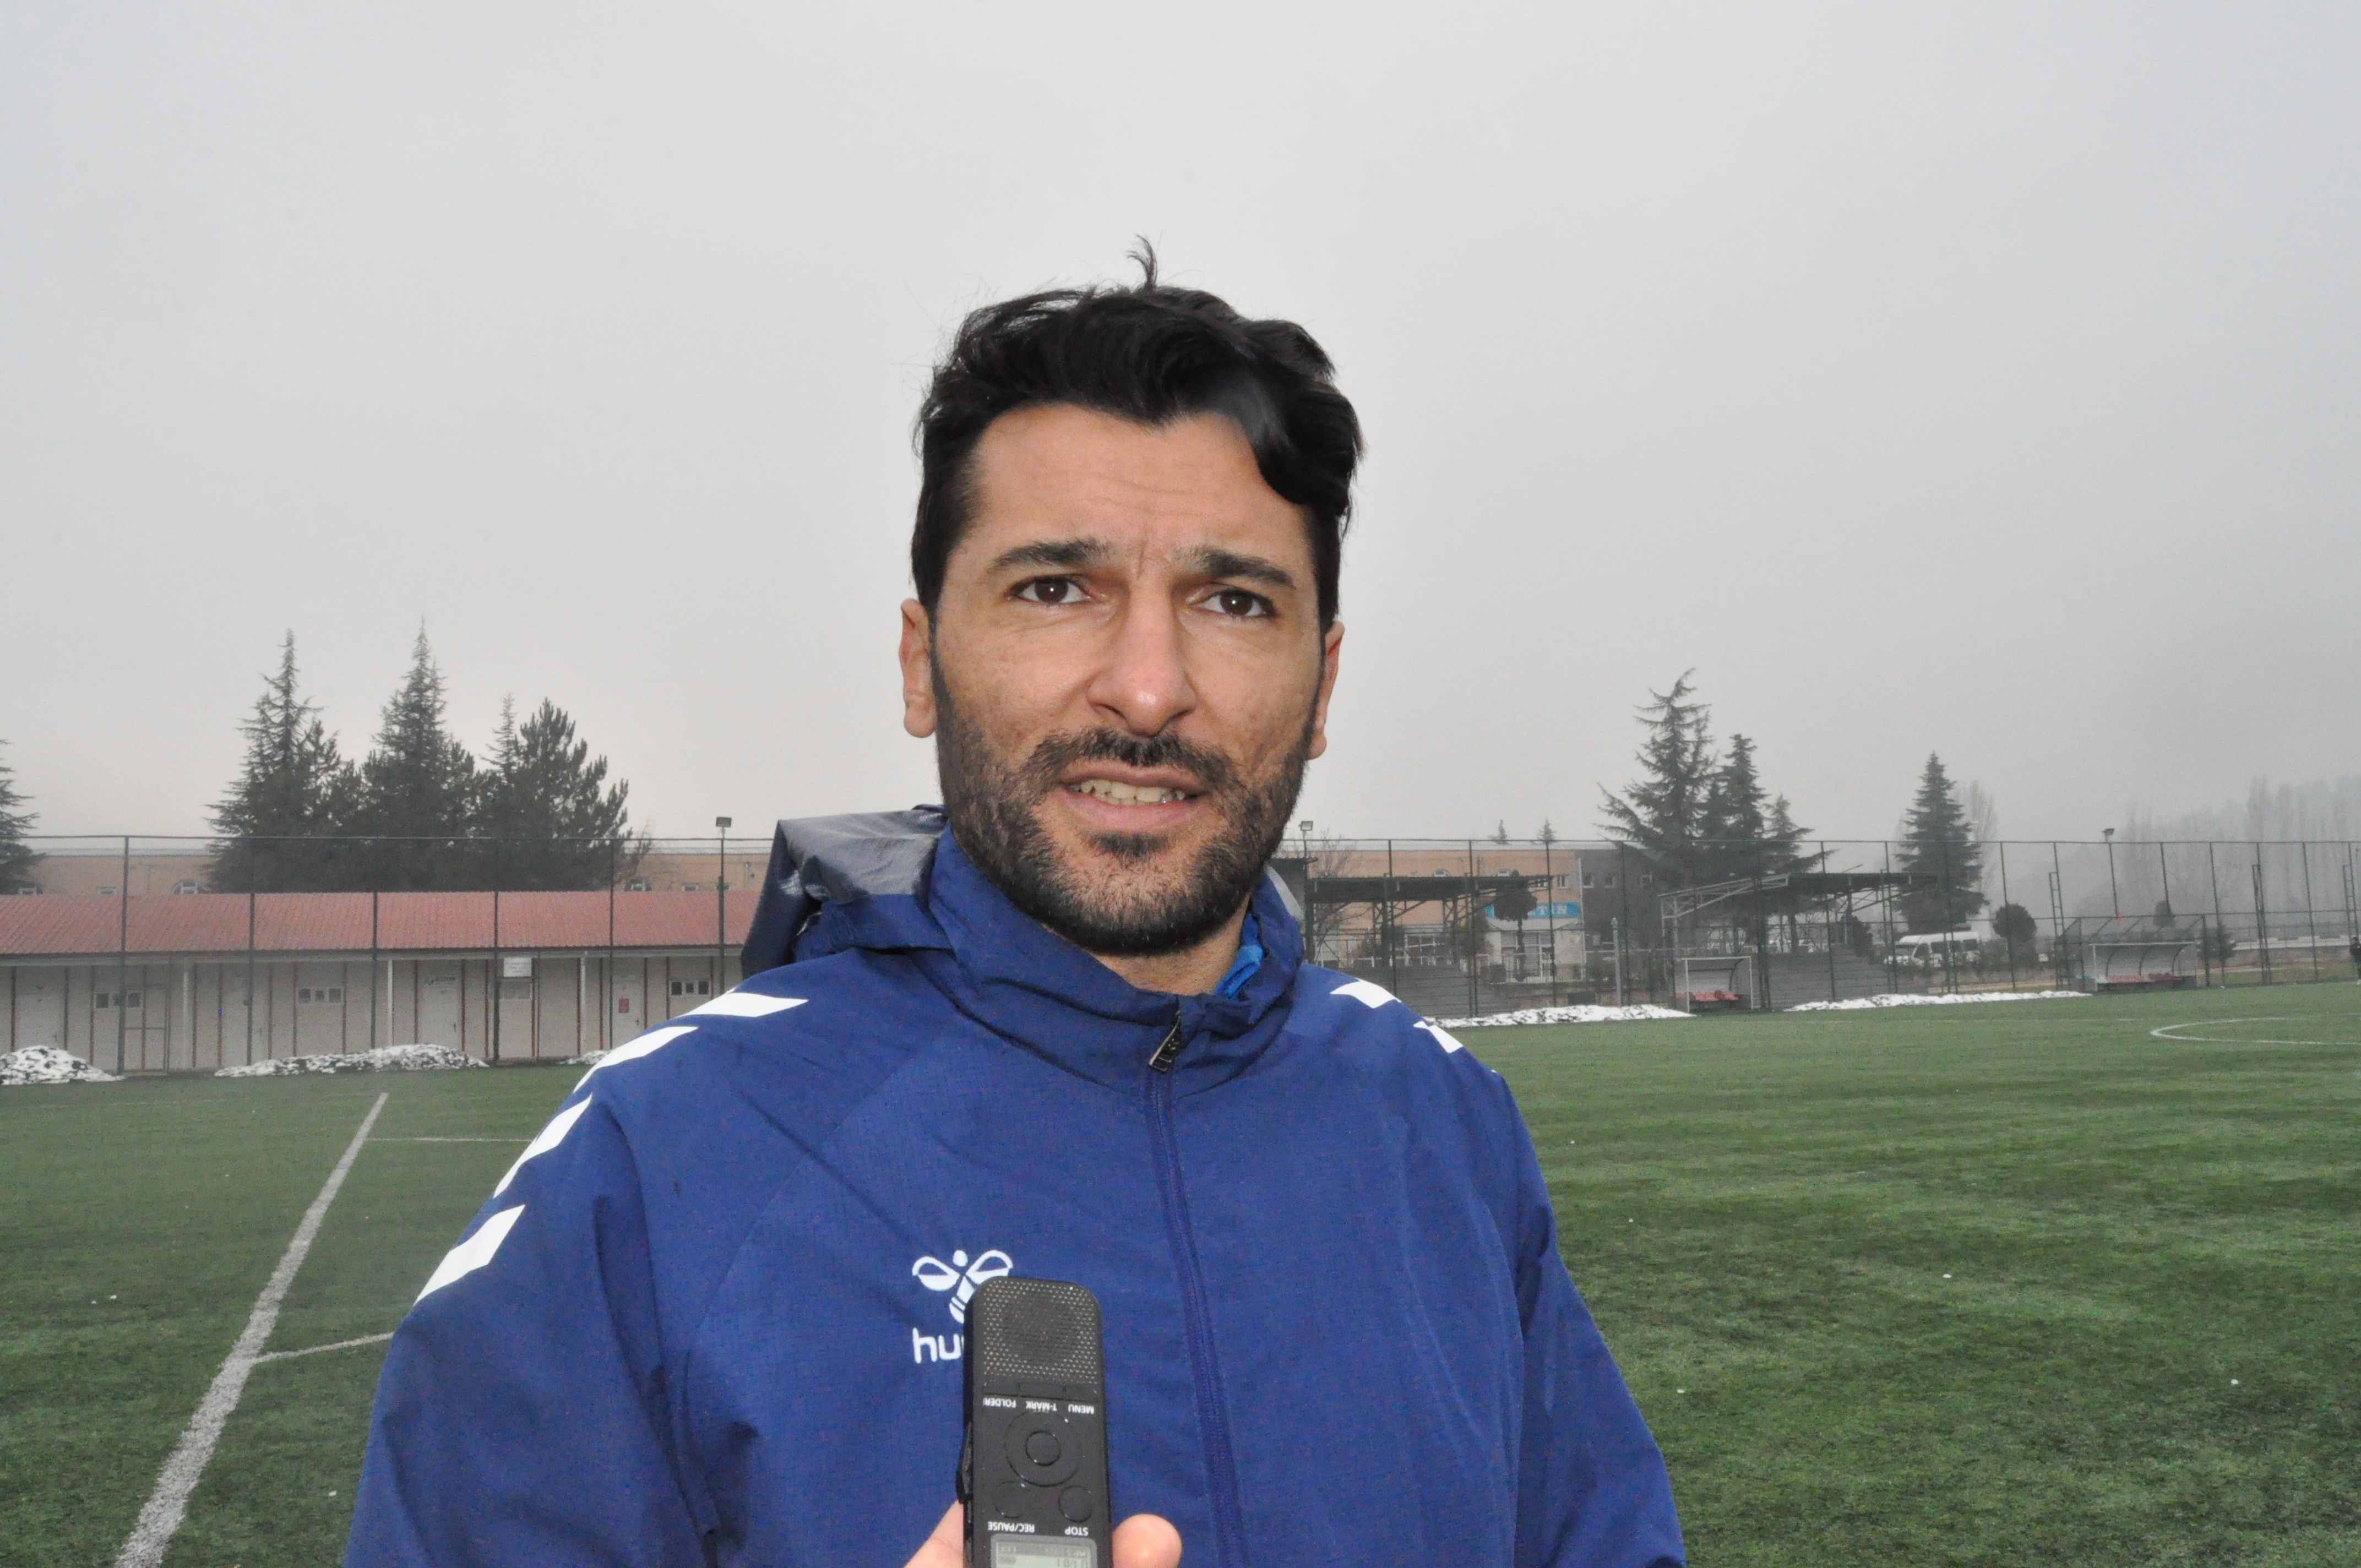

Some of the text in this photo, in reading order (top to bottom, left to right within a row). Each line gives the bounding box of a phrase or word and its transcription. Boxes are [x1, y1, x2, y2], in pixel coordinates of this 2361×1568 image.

[912, 1327, 964, 1364] hu
[984, 1397, 1016, 1408] FOLDER
[1026, 1400, 1057, 1412] T-MARK
[1068, 1404, 1095, 1414] MENU
[987, 1521, 1035, 1533] REC/PAUSE
[1064, 1526, 1089, 1536] STOP
